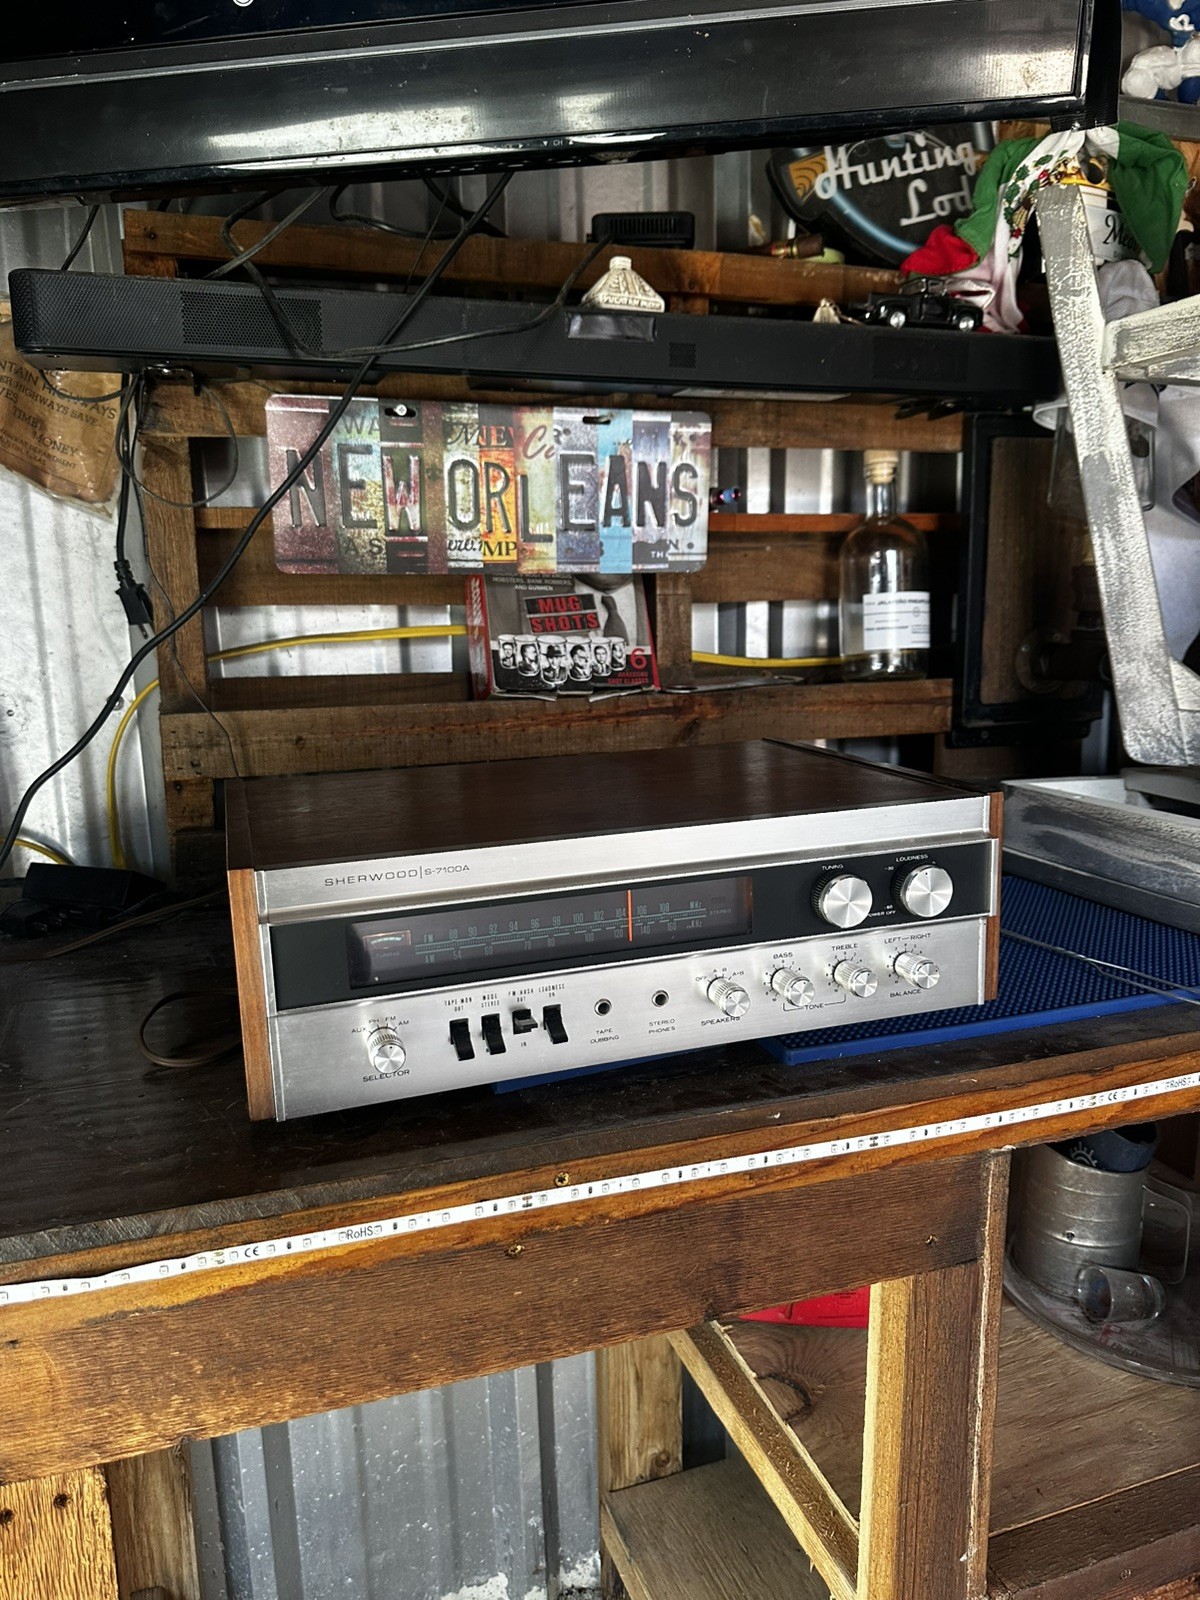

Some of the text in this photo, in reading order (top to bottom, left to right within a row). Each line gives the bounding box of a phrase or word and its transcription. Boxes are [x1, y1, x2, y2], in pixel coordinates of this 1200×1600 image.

[552, 139, 564, 147] CH
[814, 132, 981, 200] Hunting
[15, 381, 70, 415] HIGHWAYS
[285, 441, 699, 544] NEW ORLEANS
[537, 595, 581, 614] MUG
[530, 613, 600, 633] SHOTS
[630, 647, 648, 670] 6
[895, 853, 929, 863] LOUDNESS
[822, 863, 844, 871] TUNING
[324, 864, 471, 887] SHERWOOD S-7100A
[423, 933, 434, 943] FM
[448, 928, 459, 940] 88
[468, 926, 478, 937] 90
[488, 923, 498, 934] 92
[509, 920, 519, 932] 94
[530, 918, 540, 929] 96
[552, 915, 561, 926] 98
[572, 912, 584, 924] 100
[594, 910, 605, 920] 102
[616, 907, 626, 917] 104
[637, 904, 648, 915] 106
[659, 902, 670, 912] 108
[884, 932, 931, 944] LEFT RIGHT
[425, 953, 436, 963] AM
[453, 949, 463, 960] 54
[484, 945, 494, 956] 60
[524, 940, 532, 950] 70
[584, 932, 595, 942] 100
[614, 928, 624, 939] 120
[831, 943, 859, 951] TREBLE
[773, 951, 794, 959] BASS
[538, 983, 565, 993] LOUDNESS
[889, 989, 922, 998] BALANCE
[444, 998, 458, 1006] TAPE
[481, 999, 500, 1008] STEREO
[804, 1002, 825, 1010] TONE
[648, 1018, 676, 1027] STEREO
[700, 1015, 741, 1027] SPEAKERS
[596, 1027, 614, 1035] TAPE
[648, 1026, 676, 1034] PHONES
[590, 1034, 620, 1044] DUBBING
[362, 1068, 411, 1083] SELECTOR
[346, 1225, 374, 1240] RoHS
